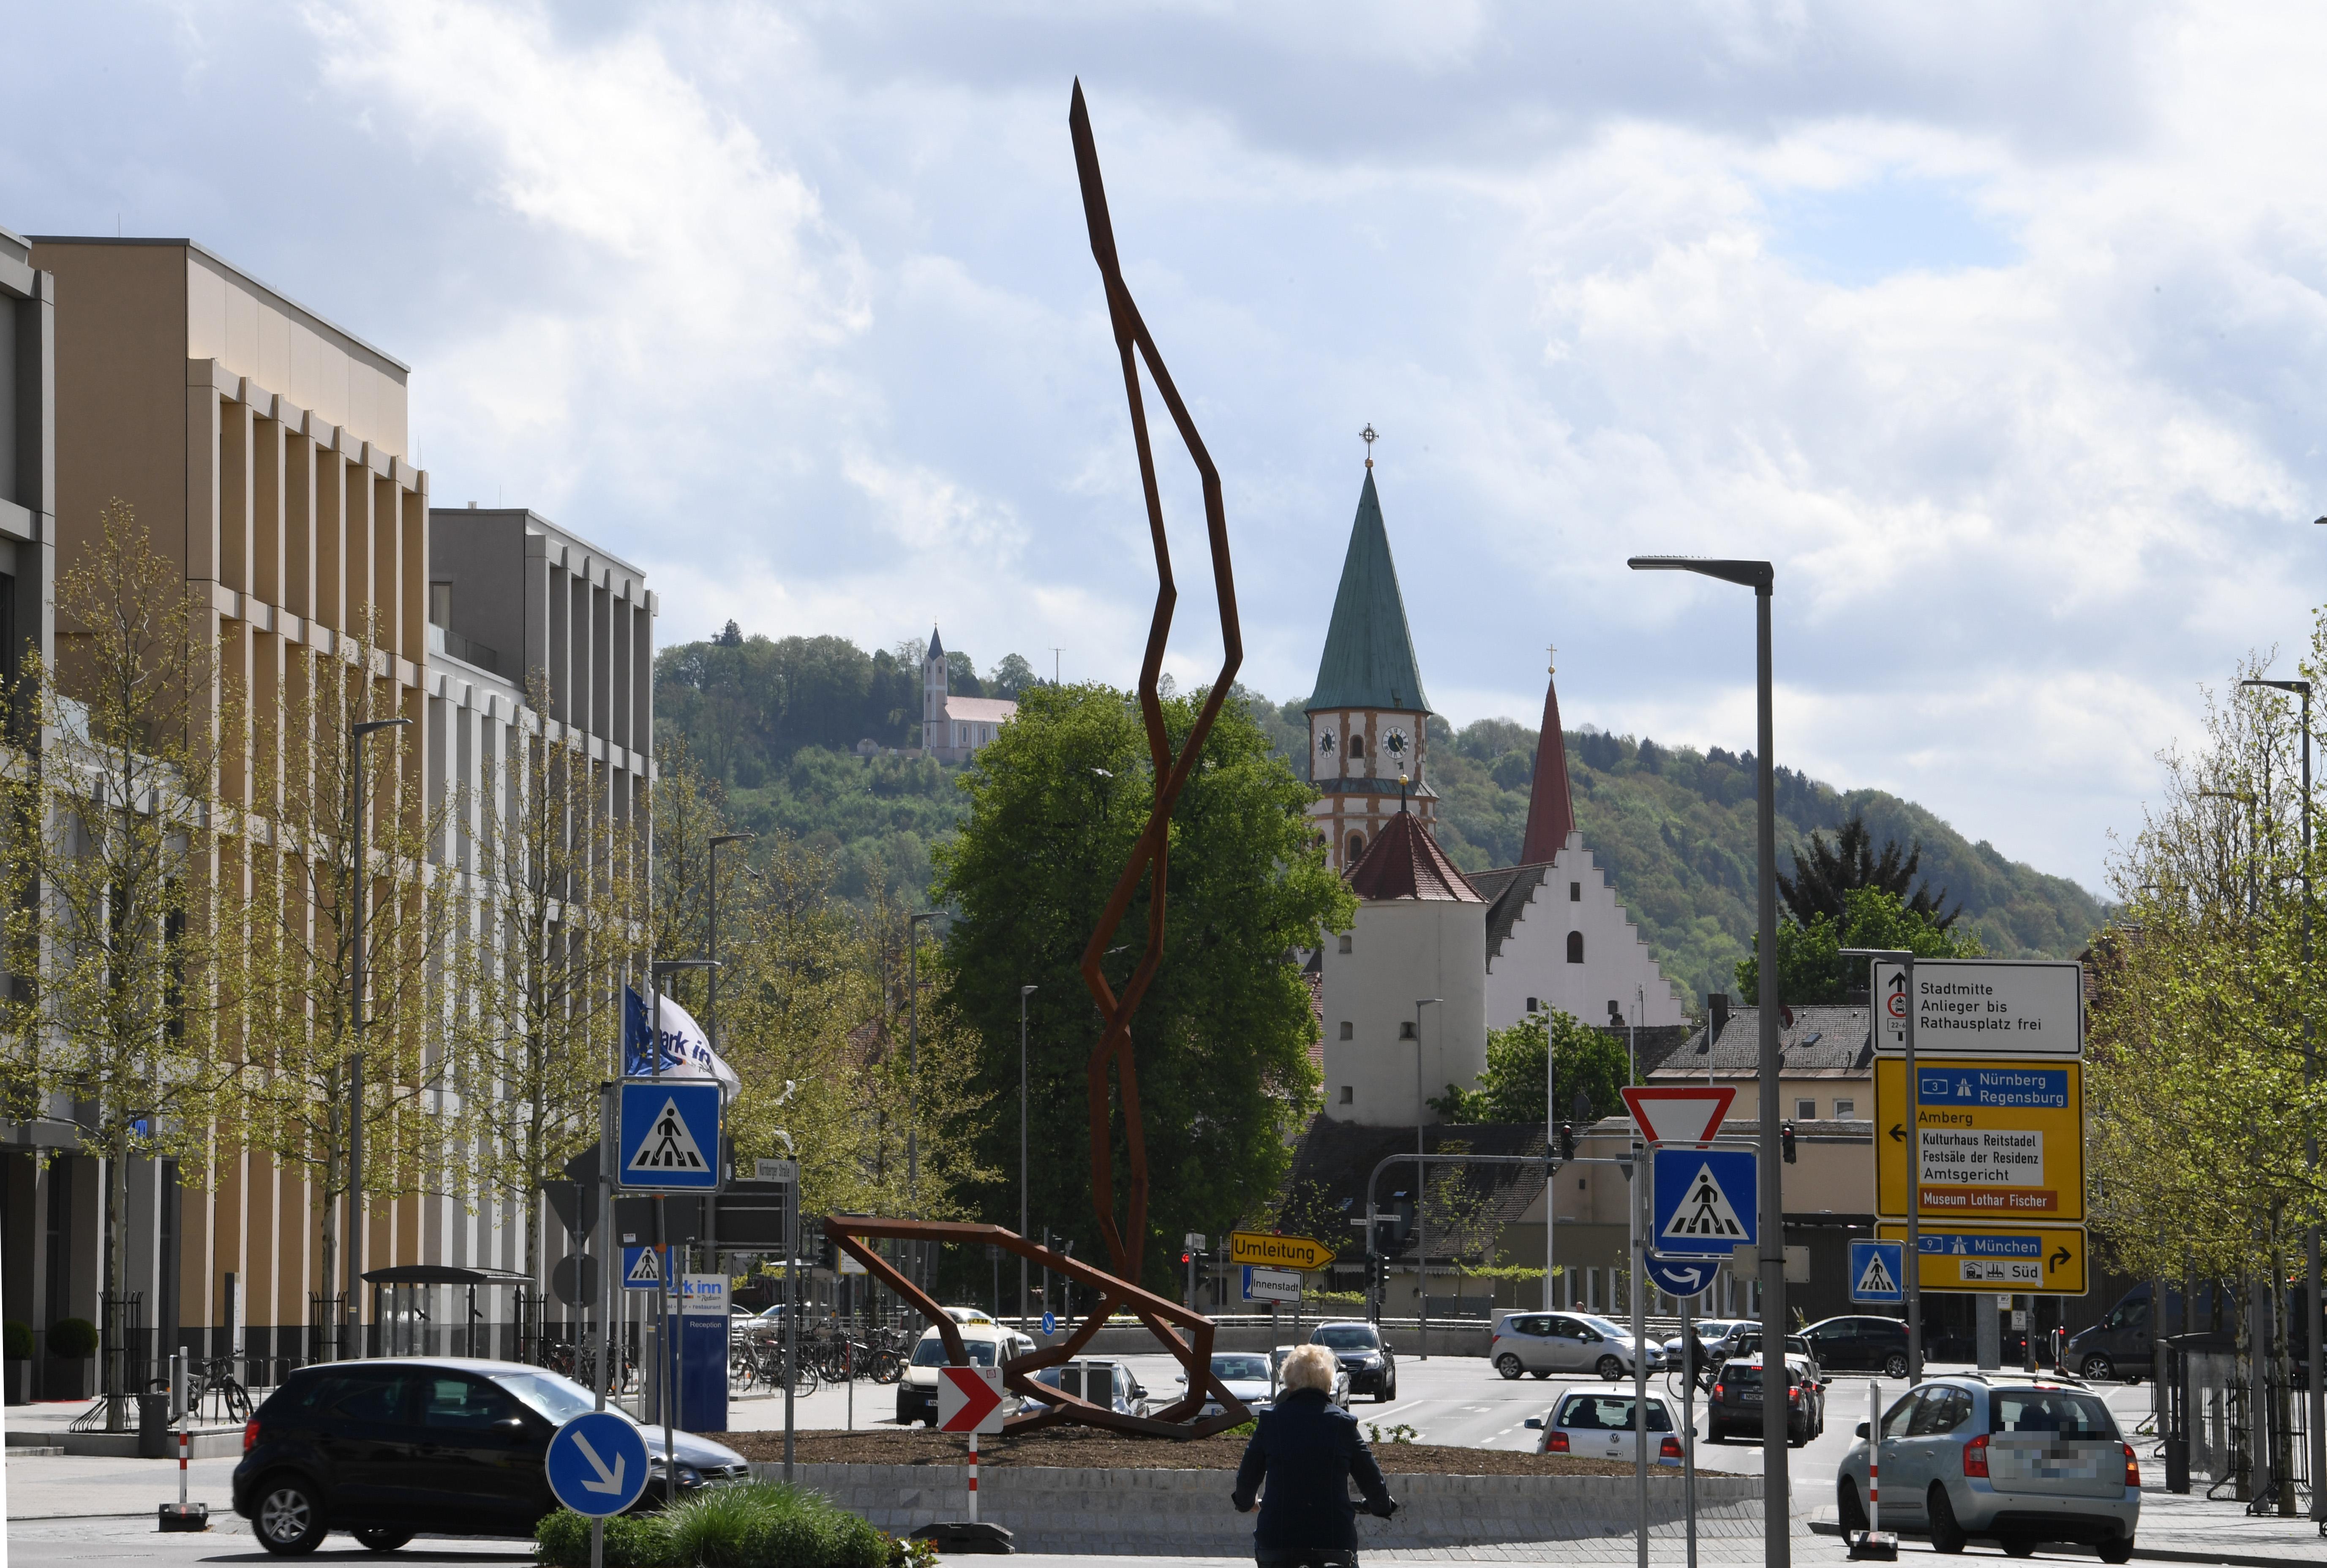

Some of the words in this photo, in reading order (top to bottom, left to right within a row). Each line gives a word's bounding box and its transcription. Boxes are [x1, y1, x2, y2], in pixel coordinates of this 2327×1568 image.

[1921, 983, 1993, 995] Stadtmitte
[1921, 1000, 1980, 1015] Anlieger
[1987, 1001, 2008, 1013] bis
[1921, 1017, 2011, 1032] Rathausplatz
[2018, 1018, 2041, 1030] frei
[1932, 1082, 1938, 1091] 3
[1980, 1073, 2046, 1089] Nürnberg
[1980, 1090, 2064, 1107] Regensburg
[1918, 1111, 1973, 1126] Amberg
[1922, 1133, 1979, 1146] Kulturhaus
[1984, 1134, 2036, 1147] Reitstadel
[1923, 1150, 1965, 1163] Festsäle
[1970, 1152, 1988, 1163] der
[1993, 1152, 2039, 1165] Residenz
[1924, 1167, 2009, 1182] Amtsgericht
[1924, 1192, 1966, 1206] Museum
[1971, 1194, 2005, 1206] Lothar
[2009, 1195, 2047, 1207] Fischer
[1235, 1239, 1315, 1264] Umleitung
[1927, 1240, 1933, 1249] 9
[1975, 1239, 2038, 1253] München
[2011, 1266, 2038, 1278] Süd
[697, 1280, 722, 1293] inn
[1253, 1278, 1299, 1292] Innenstadt
